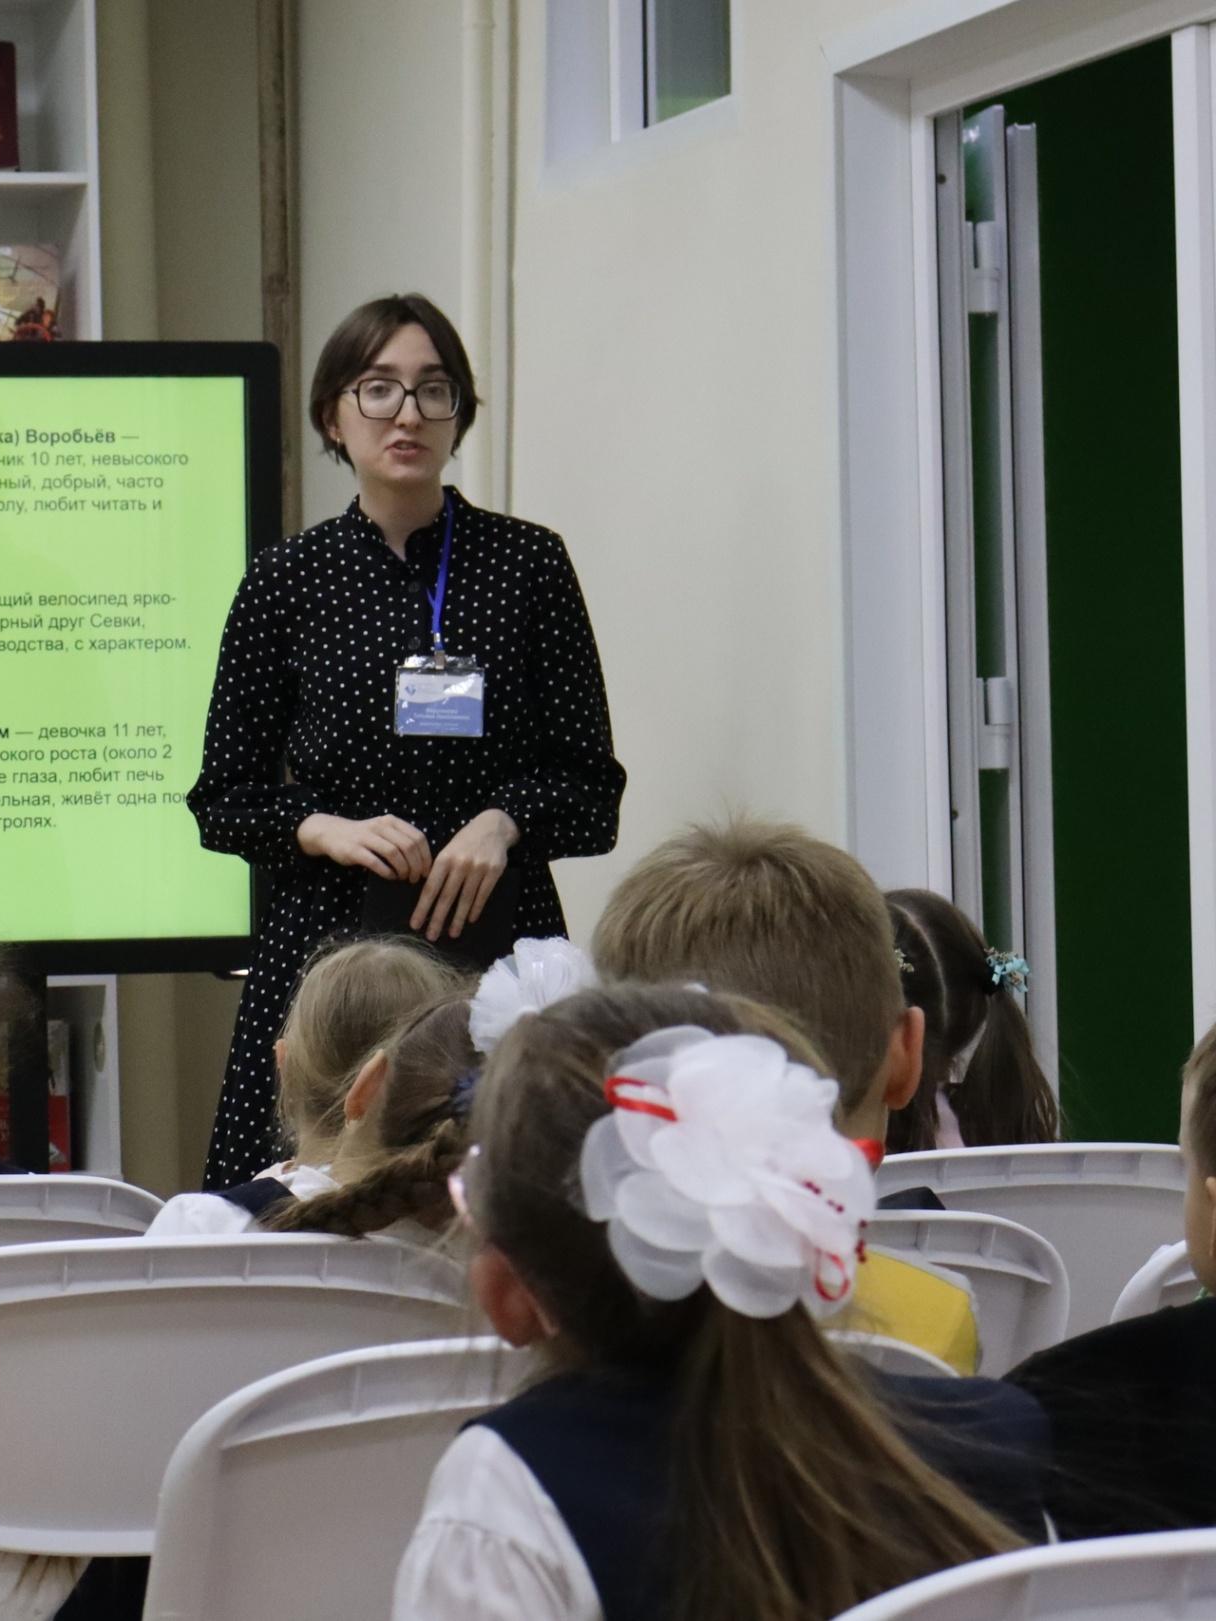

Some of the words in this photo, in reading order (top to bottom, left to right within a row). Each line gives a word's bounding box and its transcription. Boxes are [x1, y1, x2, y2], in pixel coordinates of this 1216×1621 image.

[25, 427, 116, 448] Воробьёв
[30, 450, 51, 467] 10
[54, 453, 87, 468] лет,
[91, 453, 190, 467] невысокого
[40, 473, 111, 493] добрый,
[115, 476, 165, 489] часто
[33, 495, 87, 512] любит
[90, 498, 148, 512] читать
[151, 499, 163, 511] и
[37, 593, 129, 608] велосипед
[132, 593, 177, 609] ярко-
[47, 616, 85, 633] друг
[89, 612, 146, 630] Севки,
[73, 638, 85, 652] с
[88, 637, 192, 654] характером.
[37, 726, 107, 741] девочка
[112, 722, 129, 737] 11
[135, 724, 167, 739] лет,
[49, 748, 98, 765] роста
[102, 745, 158, 763] (около
[161, 743, 173, 760] 2
[11, 771, 63, 785] глаза,
[67, 766, 121, 784] любит
[125, 769, 165, 782] печь
[60, 790, 112, 806] живёт
[116, 792, 158, 808] одна
